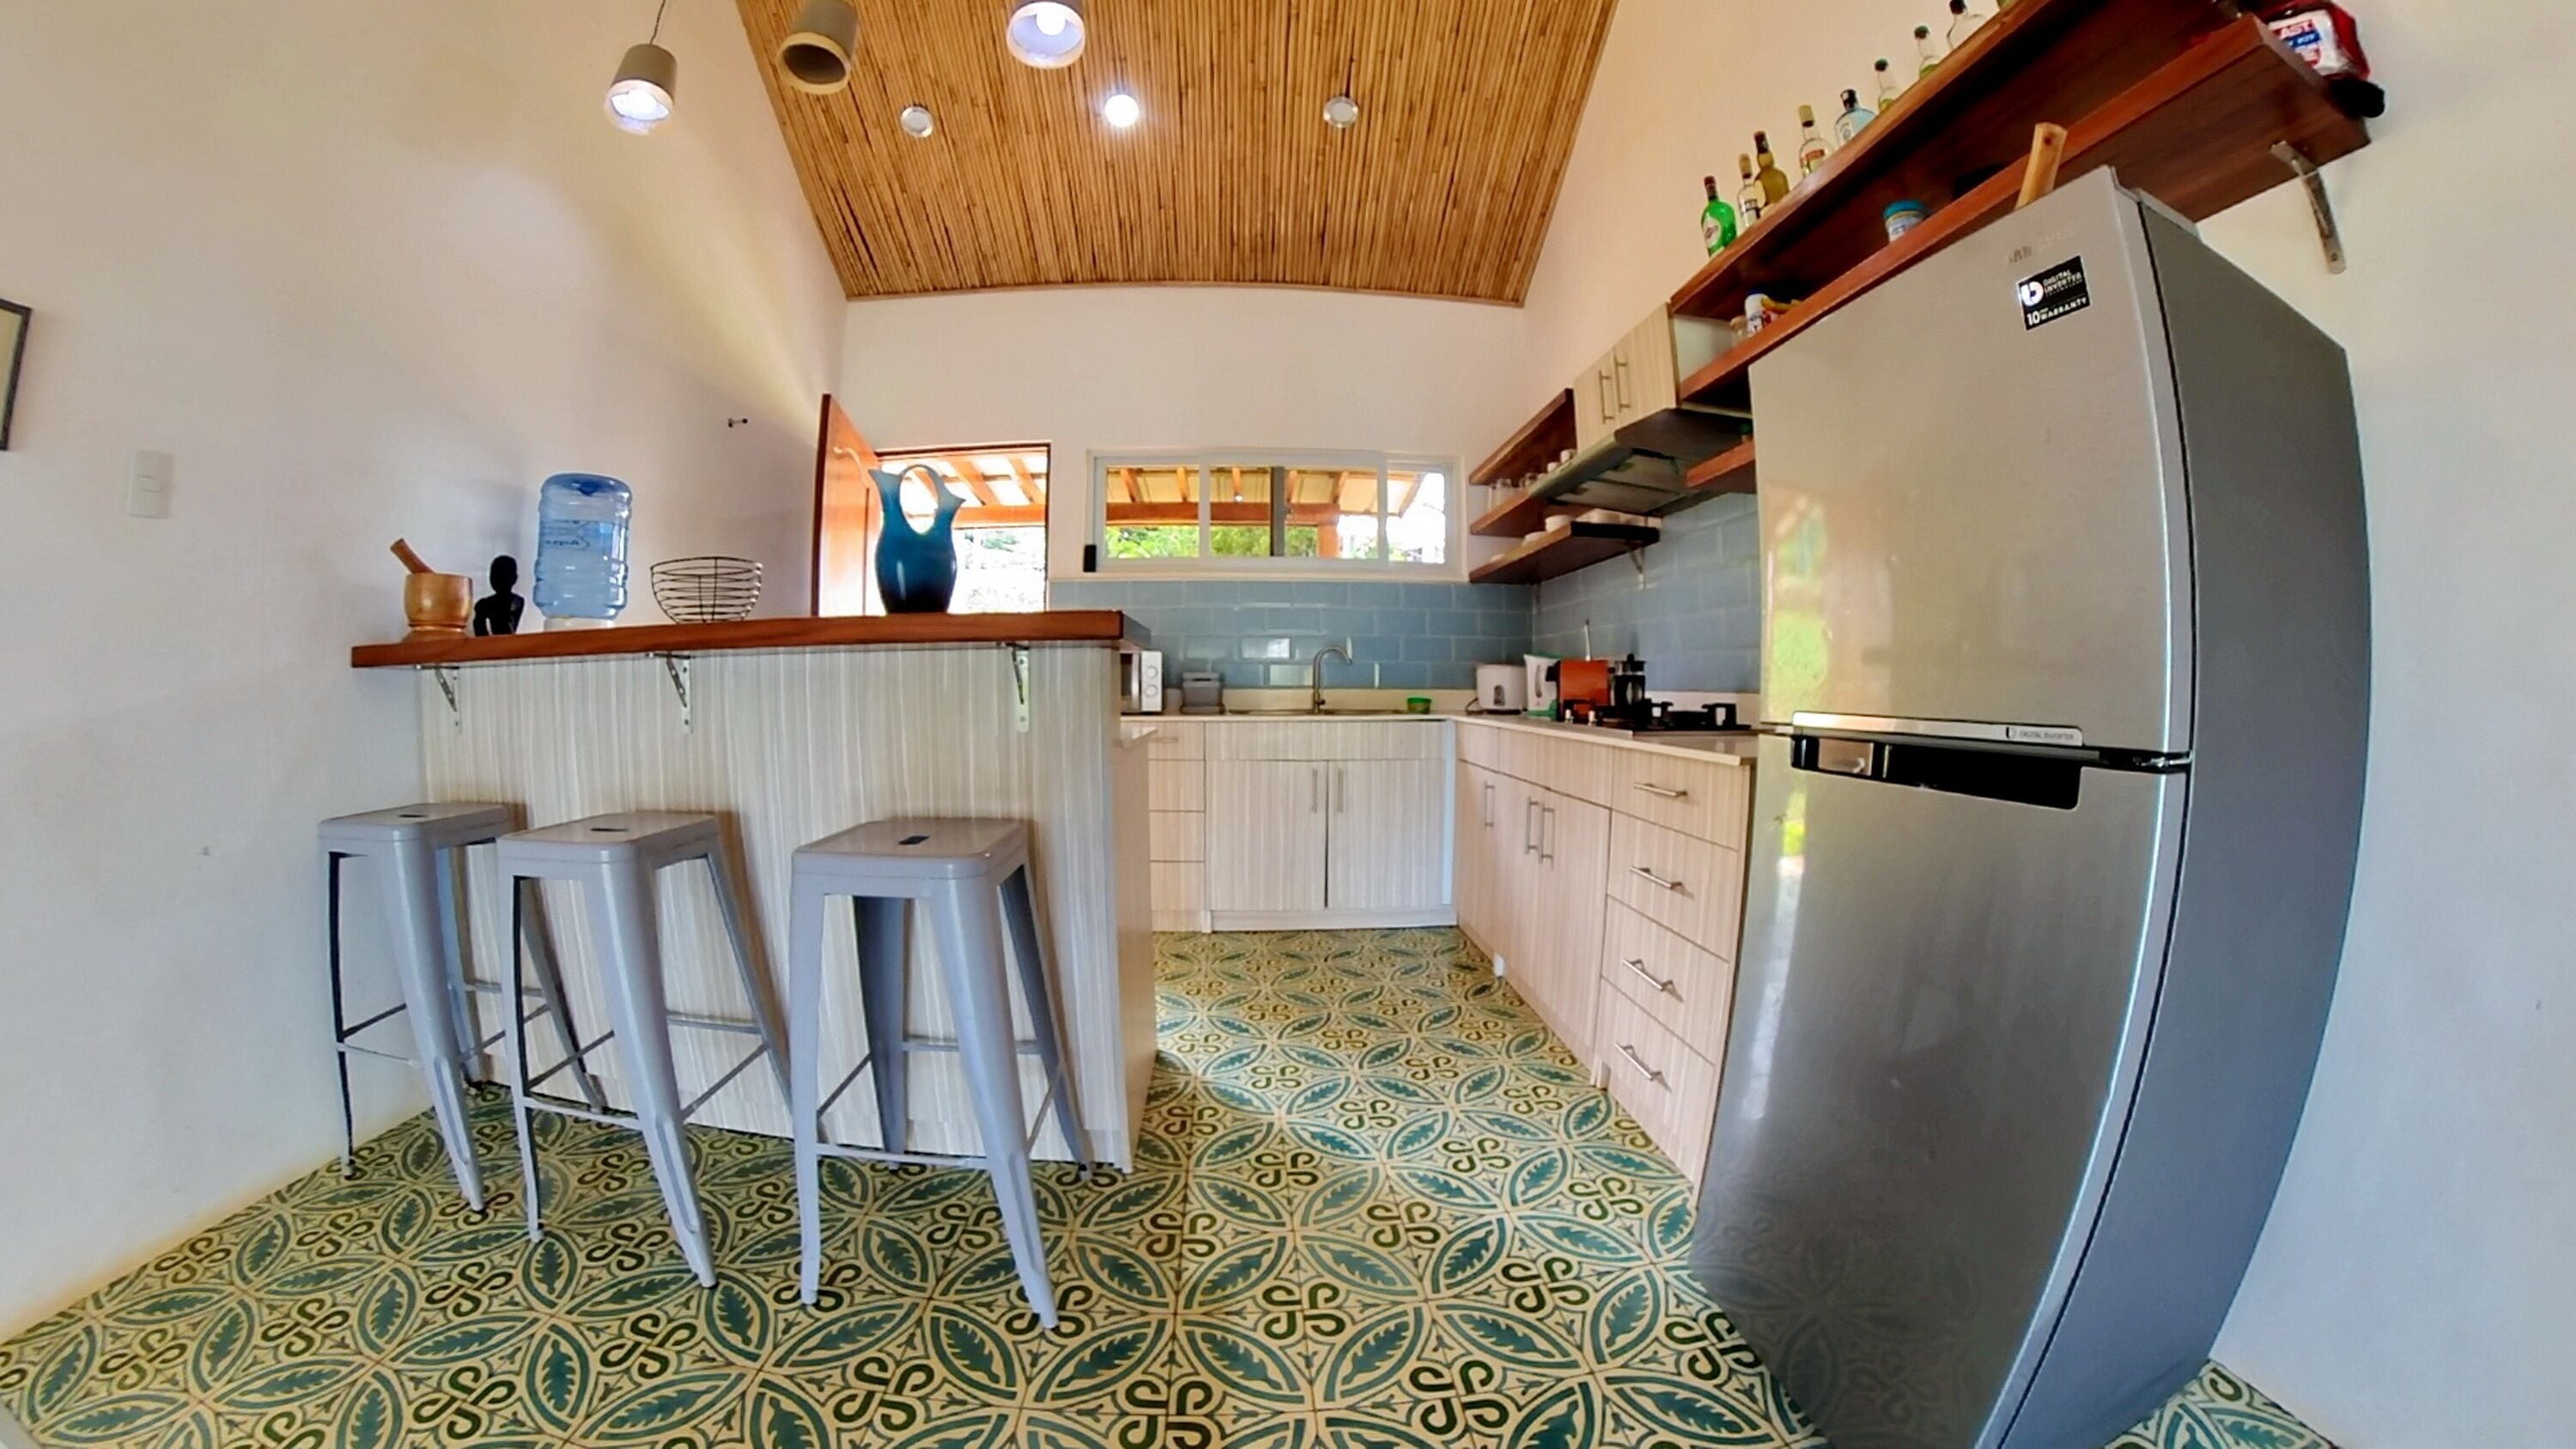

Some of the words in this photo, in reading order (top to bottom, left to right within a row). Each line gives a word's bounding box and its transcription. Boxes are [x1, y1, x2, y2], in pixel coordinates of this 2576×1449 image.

[2043, 270, 2071, 286] DIGITAL
[2044, 271, 2082, 293] INVERTER
[2026, 310, 2040, 326] 10
[2040, 297, 2087, 321] WARRANTY
